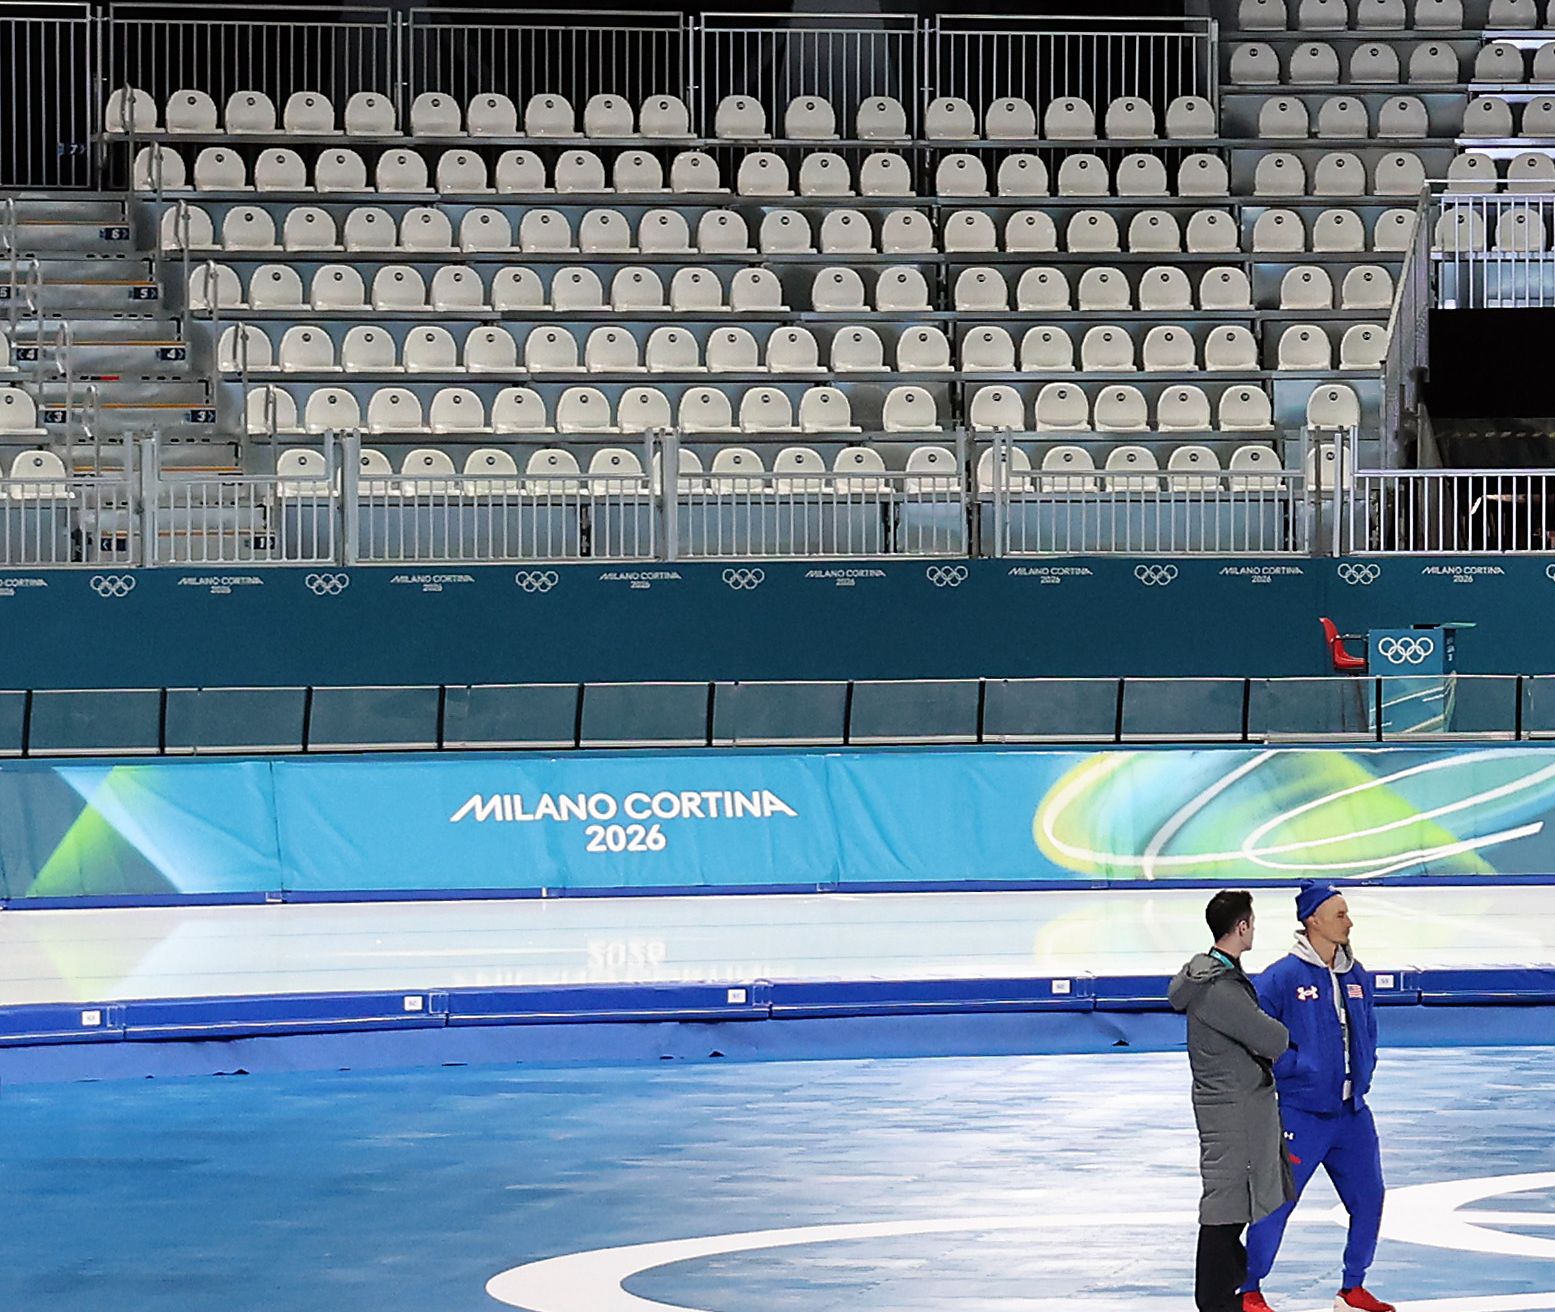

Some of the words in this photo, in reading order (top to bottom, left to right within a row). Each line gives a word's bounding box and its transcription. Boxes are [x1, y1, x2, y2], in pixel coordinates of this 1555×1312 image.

[26, 349, 35, 359] 4
[167, 349, 176, 359] 4
[55, 412, 63, 422] 3
[199, 412, 207, 421] 3
[805, 569, 845, 578] MILANO
[846, 569, 886, 578] CORTINA
[1008, 567, 1049, 576] MILANO
[1050, 567, 1093, 576] CORTINA
[1220, 566, 1260, 575] MILANO
[1262, 566, 1303, 575] CORTINA
[1422, 566, 1462, 575] MILANO
[1464, 566, 1504, 575] CORTINA
[178, 576, 220, 586] MILANO
[221, 576, 263, 586] CORTINA
[391, 574, 431, 584] MILANO
[433, 574, 474, 583] CORTINA
[600, 572, 639, 581] MILANO
[641, 572, 681, 580] CORTINA
[1454, 574, 1473, 583] 2026
[450, 793, 617, 821] MILANO
[624, 790, 797, 819] CORTINA
[585, 824, 666, 852] 2026
